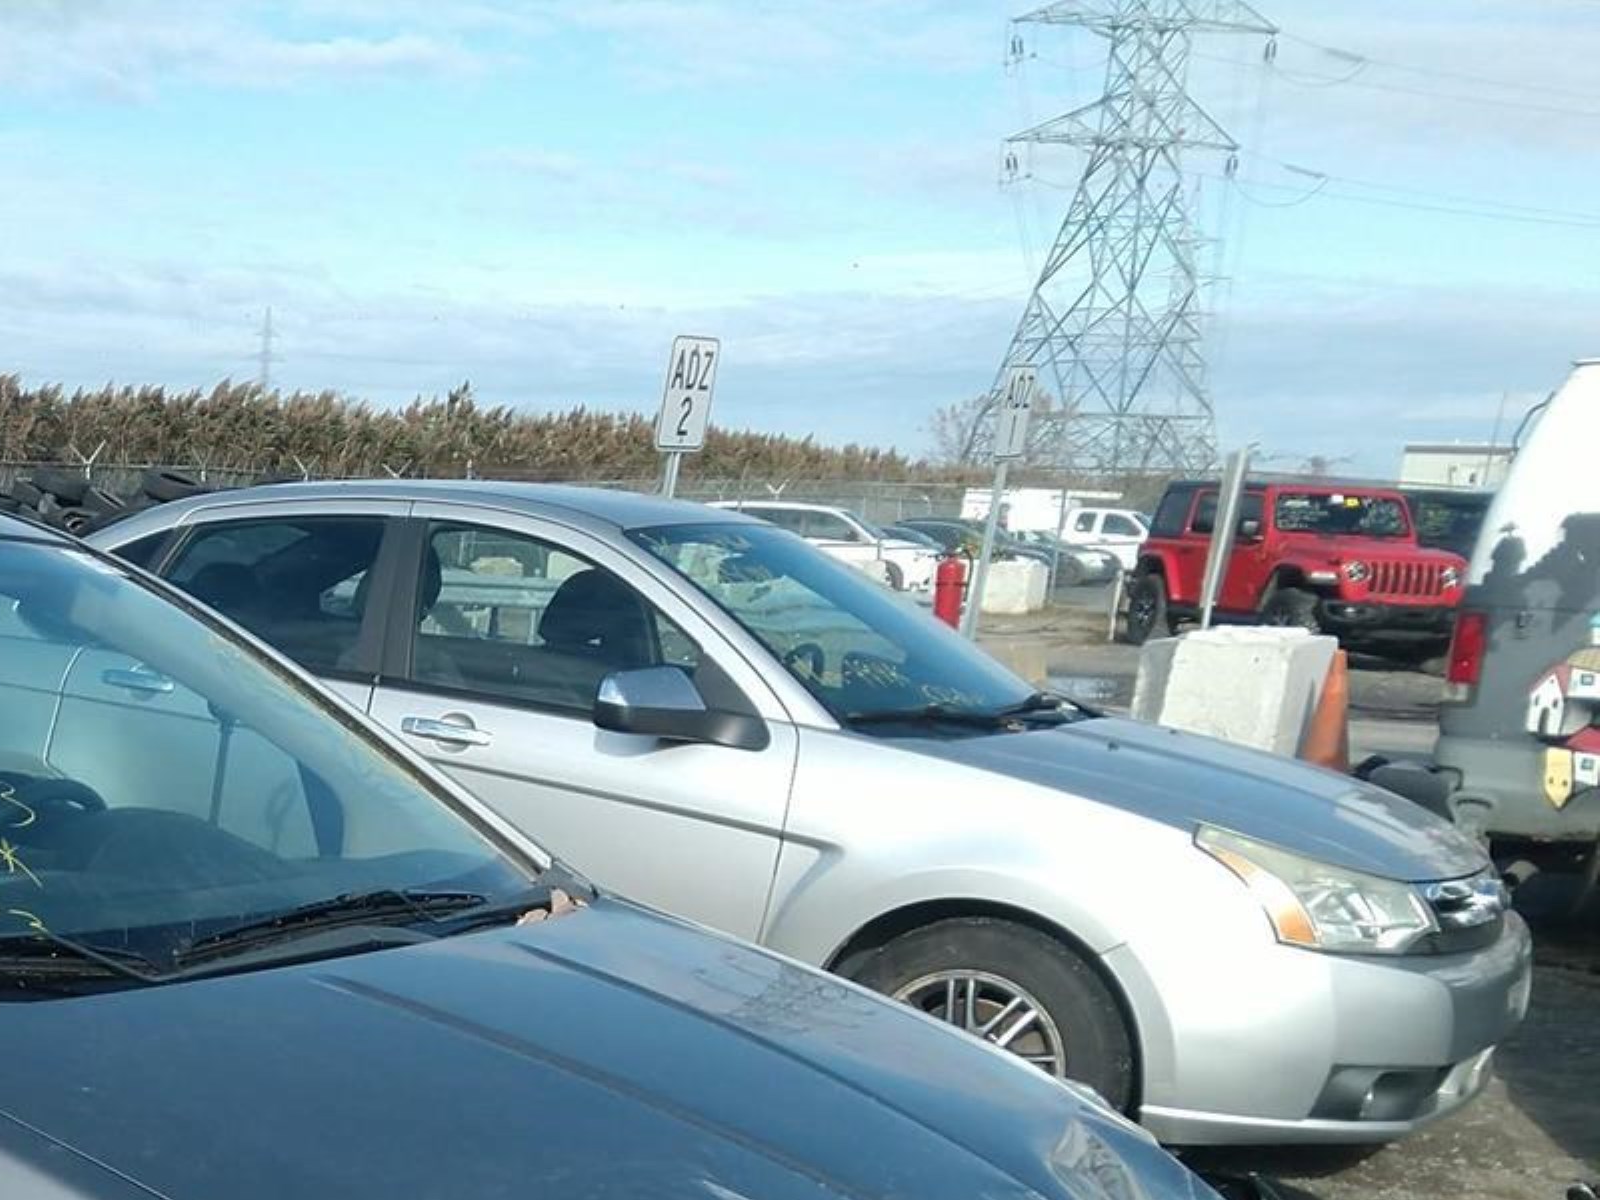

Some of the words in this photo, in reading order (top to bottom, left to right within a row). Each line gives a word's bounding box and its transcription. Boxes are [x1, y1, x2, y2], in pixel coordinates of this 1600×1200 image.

[670, 348, 715, 391] ADZ
[1007, 372, 1036, 409] ADZ
[676, 396, 693, 437] 2
